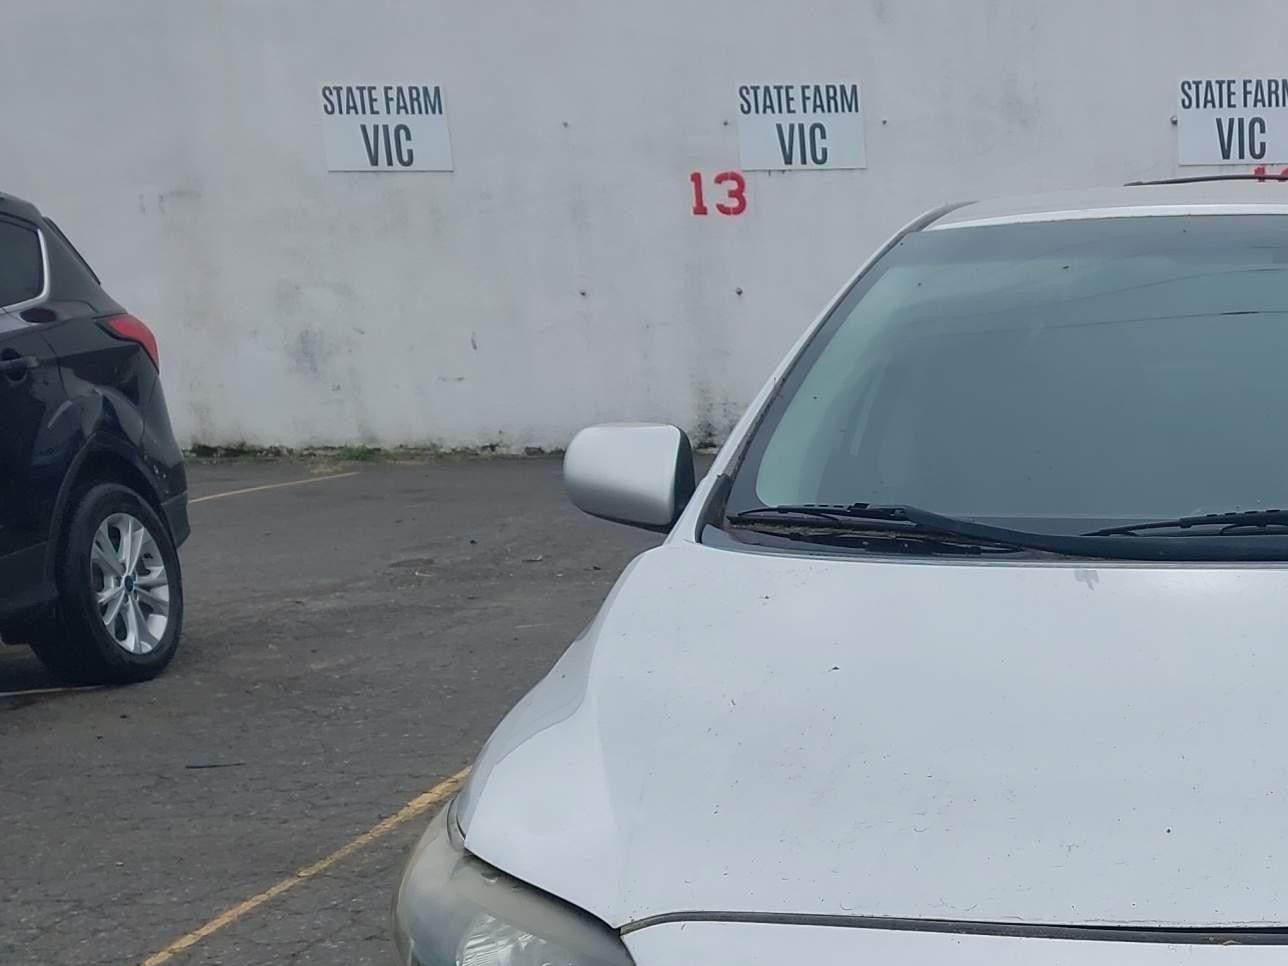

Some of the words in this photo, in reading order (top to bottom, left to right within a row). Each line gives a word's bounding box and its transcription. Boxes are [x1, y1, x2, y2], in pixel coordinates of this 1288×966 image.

[321, 85, 380, 115] STATE
[383, 85, 443, 115] FARM
[738, 85, 796, 115] STATE
[800, 84, 859, 114] FARM
[1180, 80, 1237, 110] STATE
[360, 123, 415, 167] VIC
[775, 122, 828, 166] VIC
[1215, 116, 1267, 160] VIC
[690, 171, 748, 217] 13
